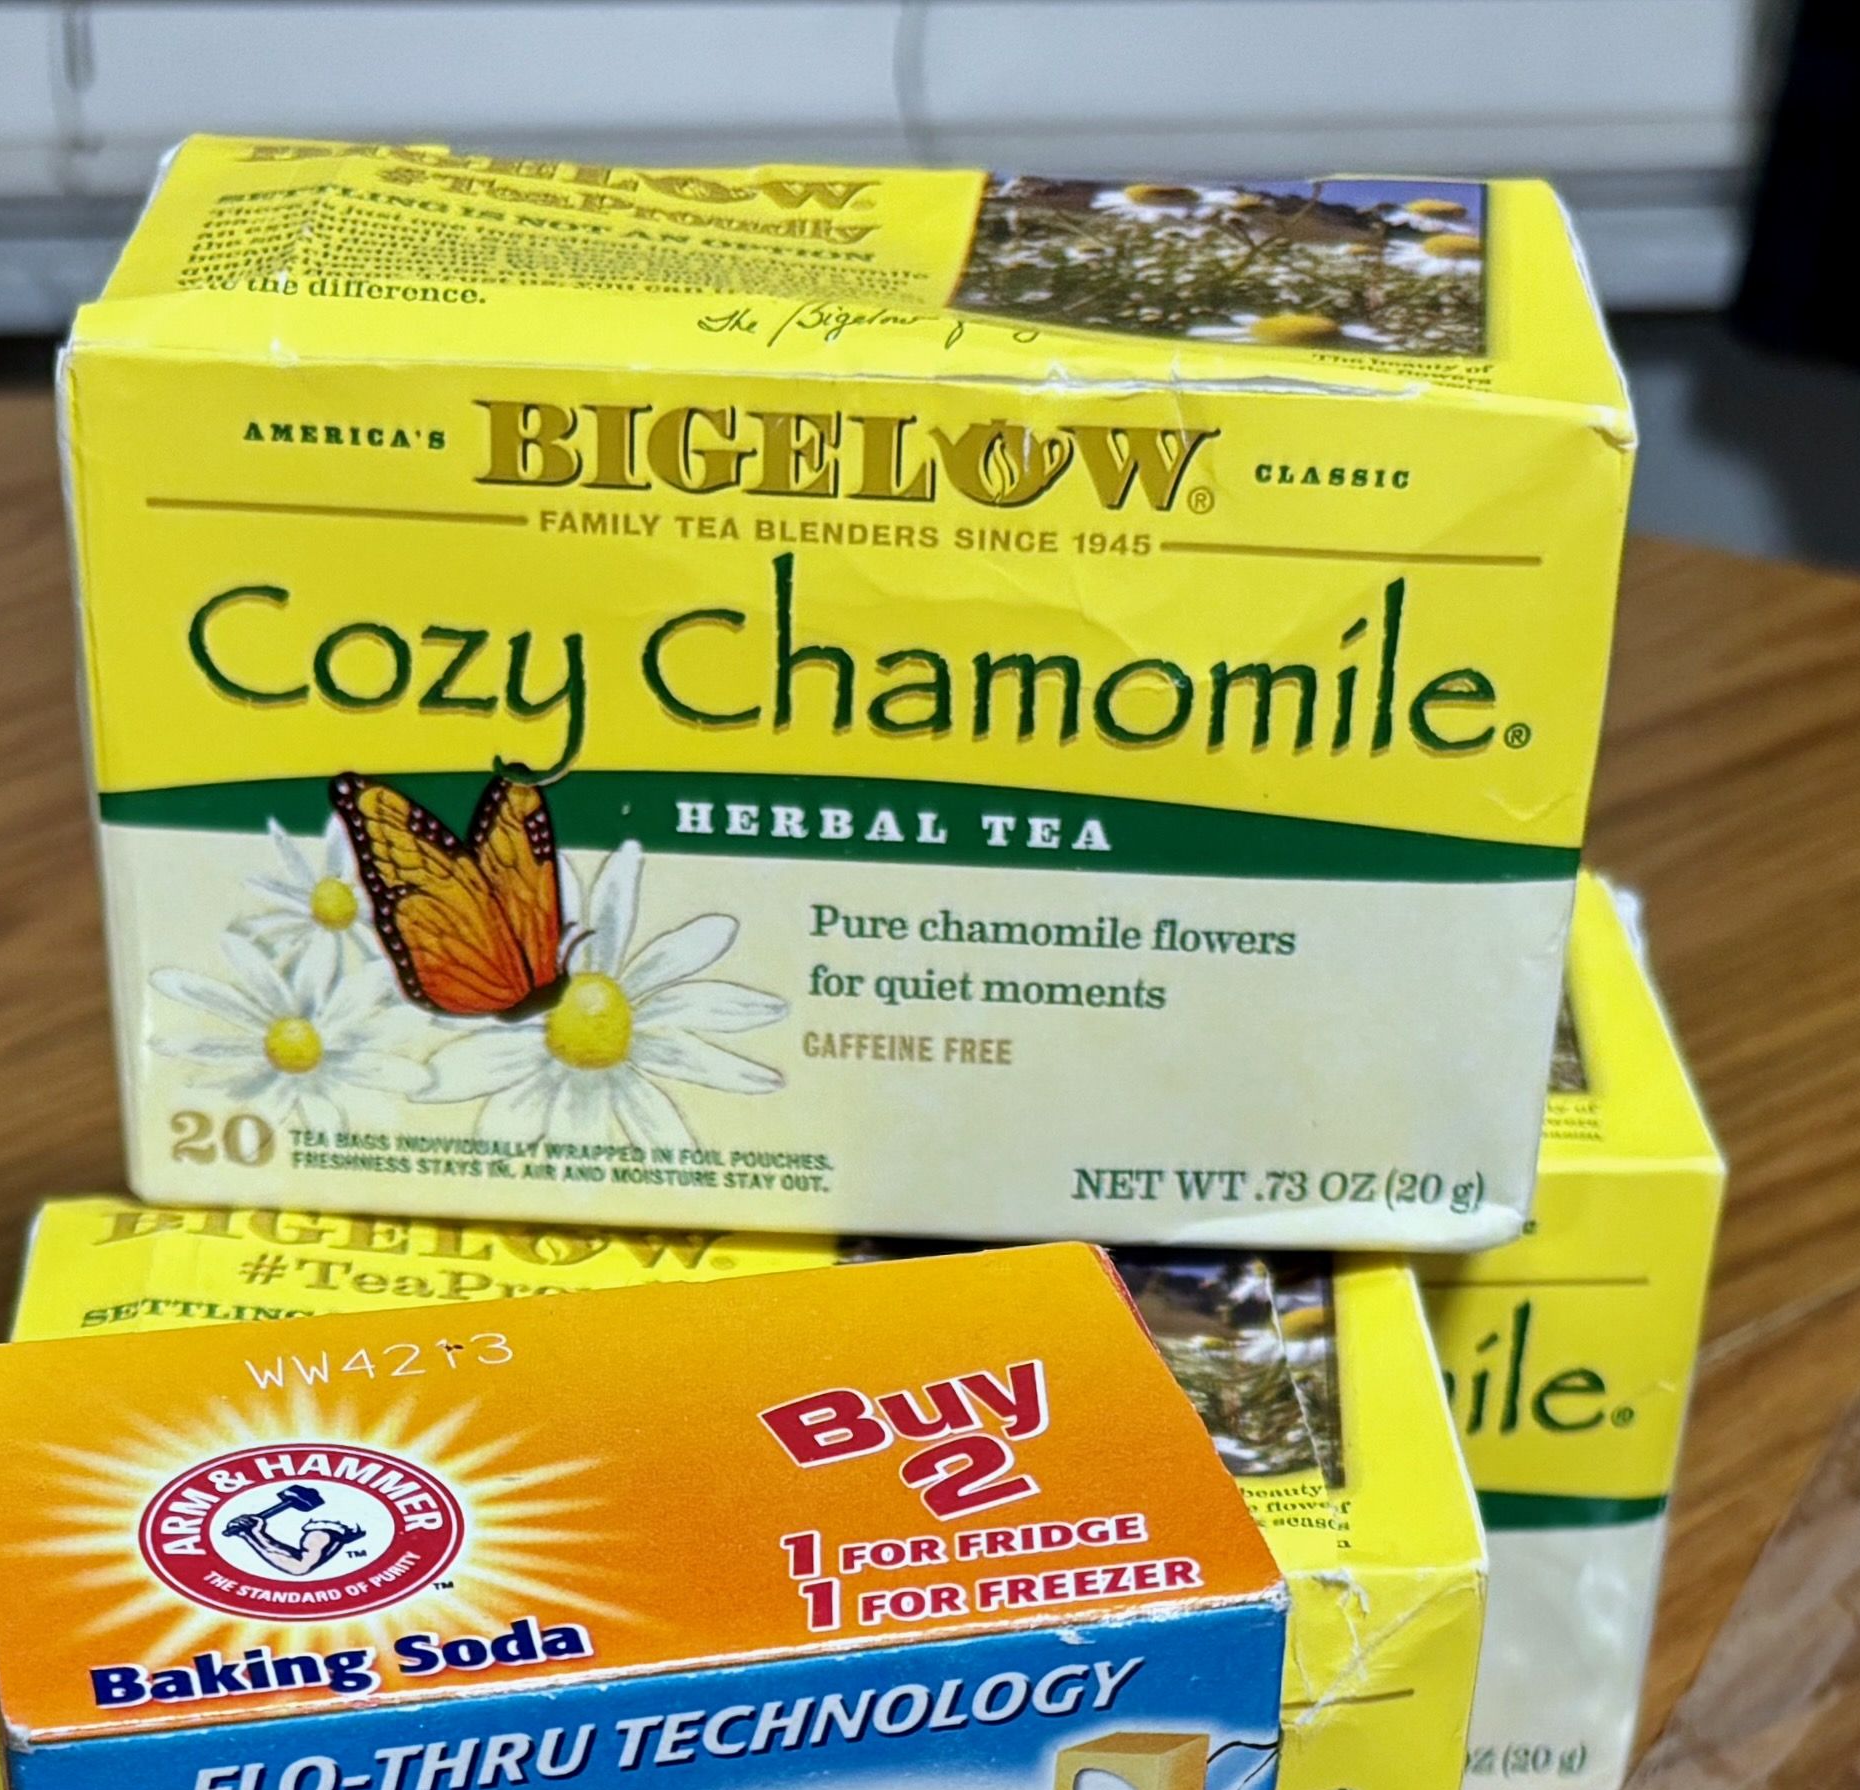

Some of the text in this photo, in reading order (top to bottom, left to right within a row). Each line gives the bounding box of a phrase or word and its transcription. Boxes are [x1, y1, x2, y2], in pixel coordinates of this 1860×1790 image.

[243, 422, 447, 450] AMERICA'S
[1254, 464, 1411, 489] CLASSIC
[540, 510, 1152, 557] FAMILY TEA BLENDERS SINCE 1945
[188, 584, 586, 786] Cozy
[676, 799, 1112, 852] HERBAL TEA
[808, 904, 1296, 956] Pure chamomile flowers
[808, 964, 1167, 1010] for quiet moments
[802, 1031, 1013, 1065] CAFFEINE FREE
[170, 1110, 276, 1168] 20
[290, 1130, 835, 1172] TEA BAGS INDIVIDUALLY WRAPPED IN FOIL POUCHES.
[291, 1150, 413, 1174] FRESHNESS
[416, 1156, 483, 1177] STAYS
[521, 1163, 558, 1181] AIR
[562, 1165, 607, 1183] AND
[611, 1167, 719, 1189] MOISTURE
[723, 1172, 777, 1191] STAY
[780, 1174, 831, 1193] OUT.
[1071, 1167, 1486, 1215] NET WT .73 OZ (20 g)
[760, 1360, 1044, 1466] Buy
[899, 1434, 1038, 1519] 2
[160, 1452, 444, 1558] ARM & HAMMER
[782, 1514, 1146, 1579] 1 FOR FRIDGE
[202, 1550, 423, 1606] THE STANDARD OF PURITY
[801, 1558, 1200, 1630] 1 FOR FREEZER
[92, 1617, 587, 1707] Baking Soda
[613, 1656, 1144, 1773] TECHNOLOGY
